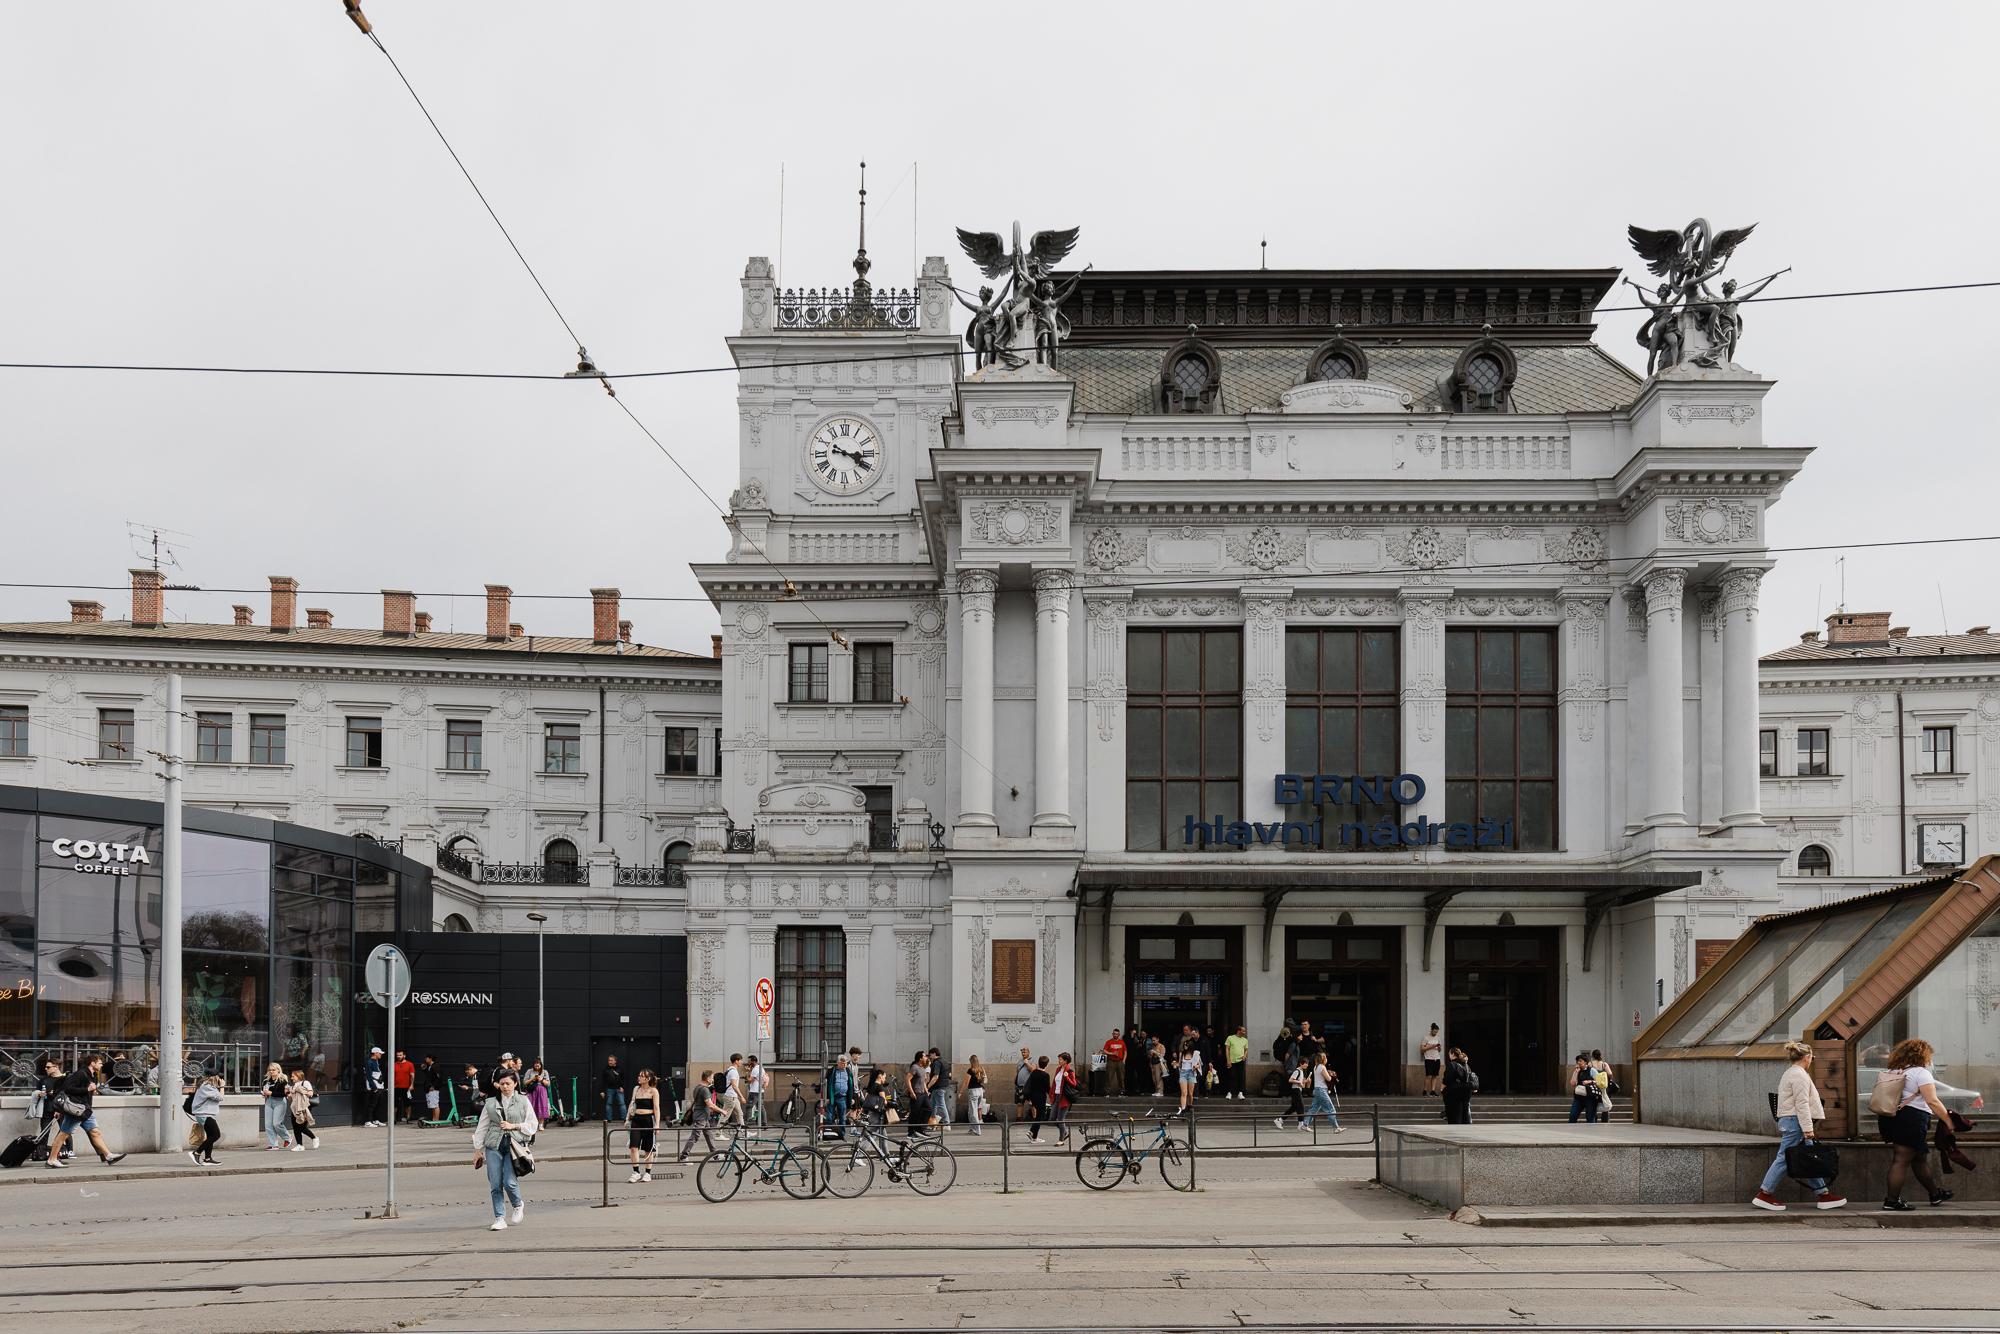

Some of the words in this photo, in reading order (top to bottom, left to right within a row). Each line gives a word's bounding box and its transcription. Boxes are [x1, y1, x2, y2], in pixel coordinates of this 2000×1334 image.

[840, 424, 850, 436] XII
[1275, 773, 1426, 805] BRNO
[1185, 815, 1321, 845] hlavní
[1341, 815, 1513, 846] nádraží
[52, 838, 150, 864] COSTA
[74, 864, 129, 875] COFFEE
[411, 992, 493, 1004] ROSSMANN
